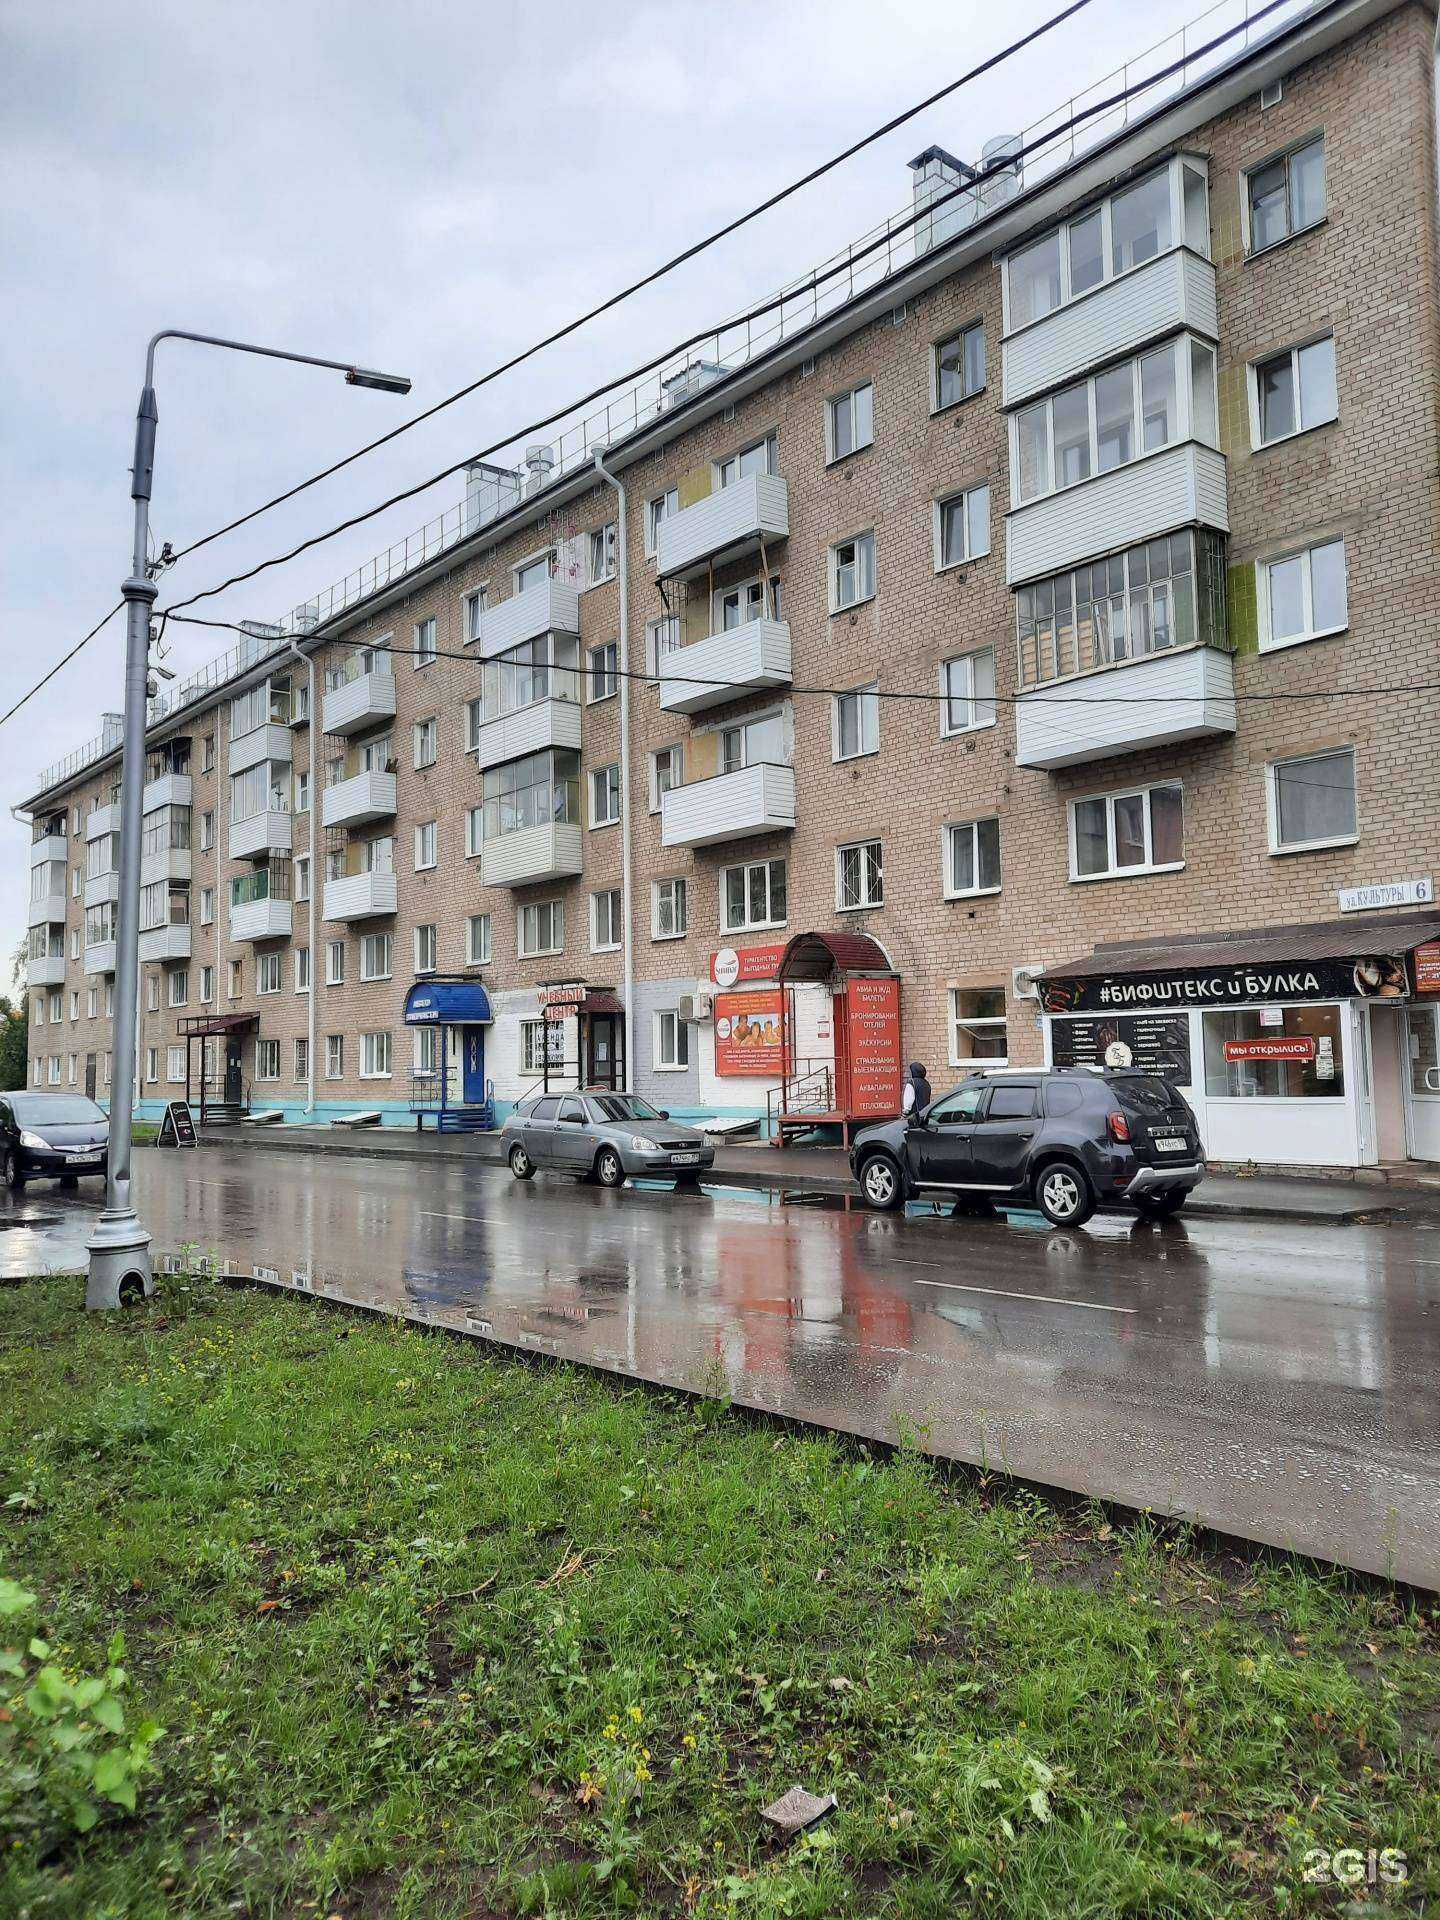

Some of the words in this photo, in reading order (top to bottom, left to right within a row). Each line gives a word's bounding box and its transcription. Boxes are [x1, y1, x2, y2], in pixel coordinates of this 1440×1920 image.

[1416, 881, 1426, 899] 6
[856, 985, 873, 993] АВИА
[1100, 978, 1224, 1003] #БИФШТЕКС
[1227, 980, 1241, 995] и
[1245, 972, 1320, 994] БУЛКА
[537, 988, 583, 1004] УЧЕБНЫЙ
[862, 994, 886, 1002] БИЛЕТЫ
[546, 1005, 576, 1020] ЦЕНТР
[851, 1012, 897, 1020] БРОНИРОВАНИЕ
[863, 1020, 886, 1029] ОТЕЛЕЙ
[858, 1039, 892, 1047] ЭКСКУРСИИ
[859, 1083, 894, 1091] АКВАПАРКИ
[859, 1102, 895, 1110] ТЕПЛОХОДЫ
